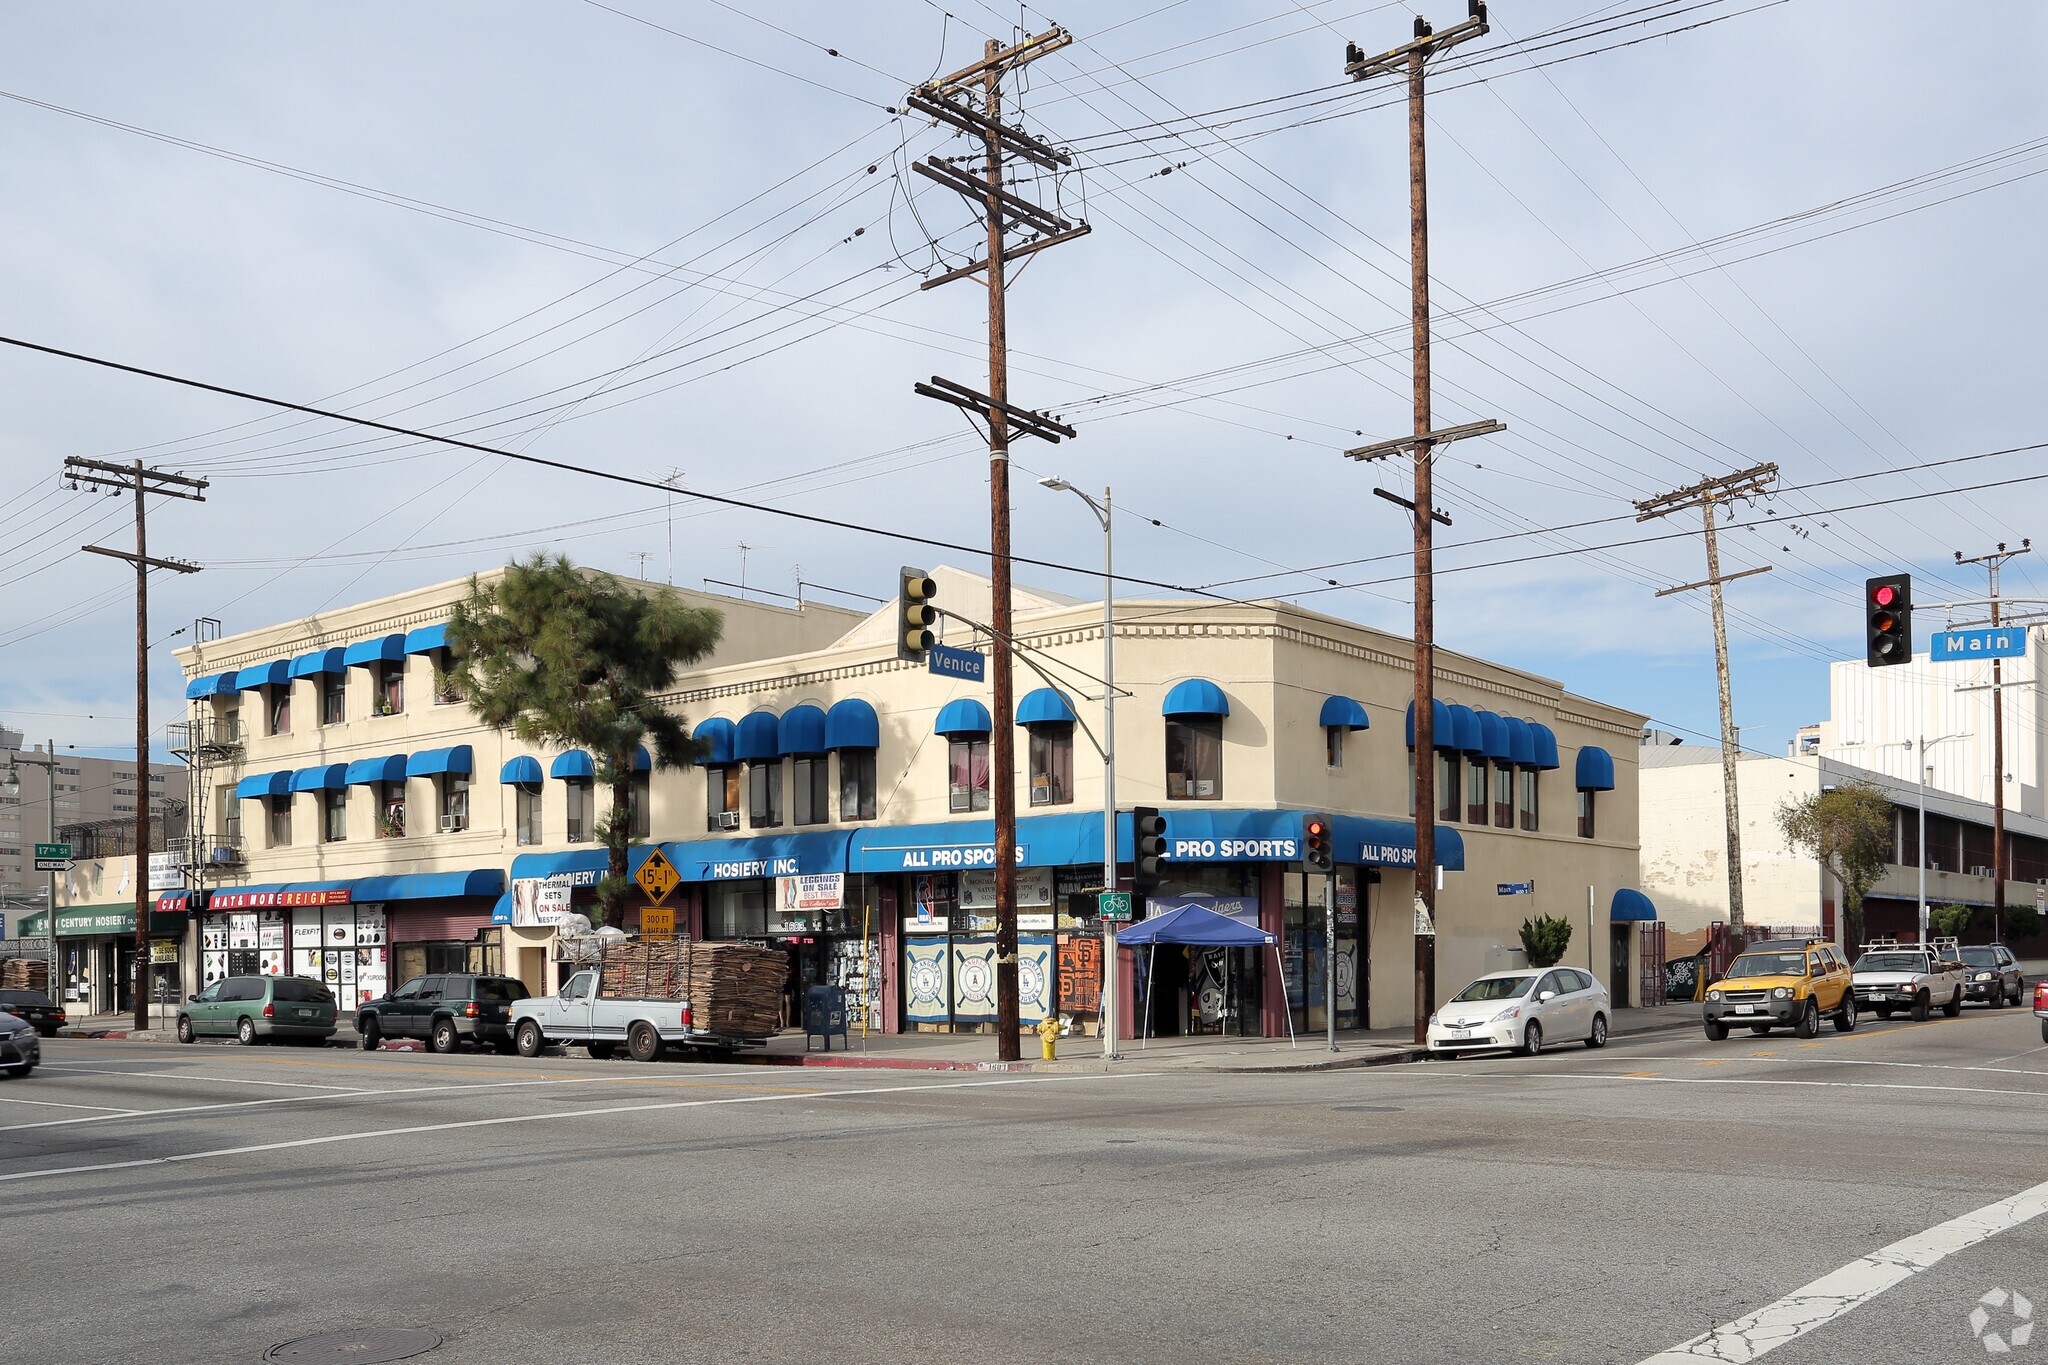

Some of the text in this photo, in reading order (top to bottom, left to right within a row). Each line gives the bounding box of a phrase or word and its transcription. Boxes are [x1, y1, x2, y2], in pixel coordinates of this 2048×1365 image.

[1947, 634, 2009, 652] Main
[934, 652, 980, 674] Venice
[39, 847, 56, 855] 17th
[1176, 840, 1296, 857] PRO SPORTS
[1362, 844, 1379, 861] ALL
[1381, 846, 1400, 863] PRO
[902, 846, 1024, 867] ALL PRO SPOS
[714, 858, 799, 878] HOSIERY INC.
[800, 874, 840, 884] LEGGINGS
[539, 880, 570, 890] THERMAL
[817, 883, 837, 891] SALE
[1058, 882, 1081, 894] MAN
[250, 893, 282, 905] MORE
[287, 892, 326, 904] REIGN
[544, 891, 562, 900] SETS
[161, 900, 181, 910] CAP
[540, 903, 570, 913] ON SALE
[61, 917, 92, 928] CENTURY
[95, 915, 126, 926] HOSIERY
[646, 915, 669, 923] 300 FT
[231, 921, 258, 932] MAIN
[294, 928, 320, 936] FLEXFIT
[920, 960, 940, 980] ANGELES
